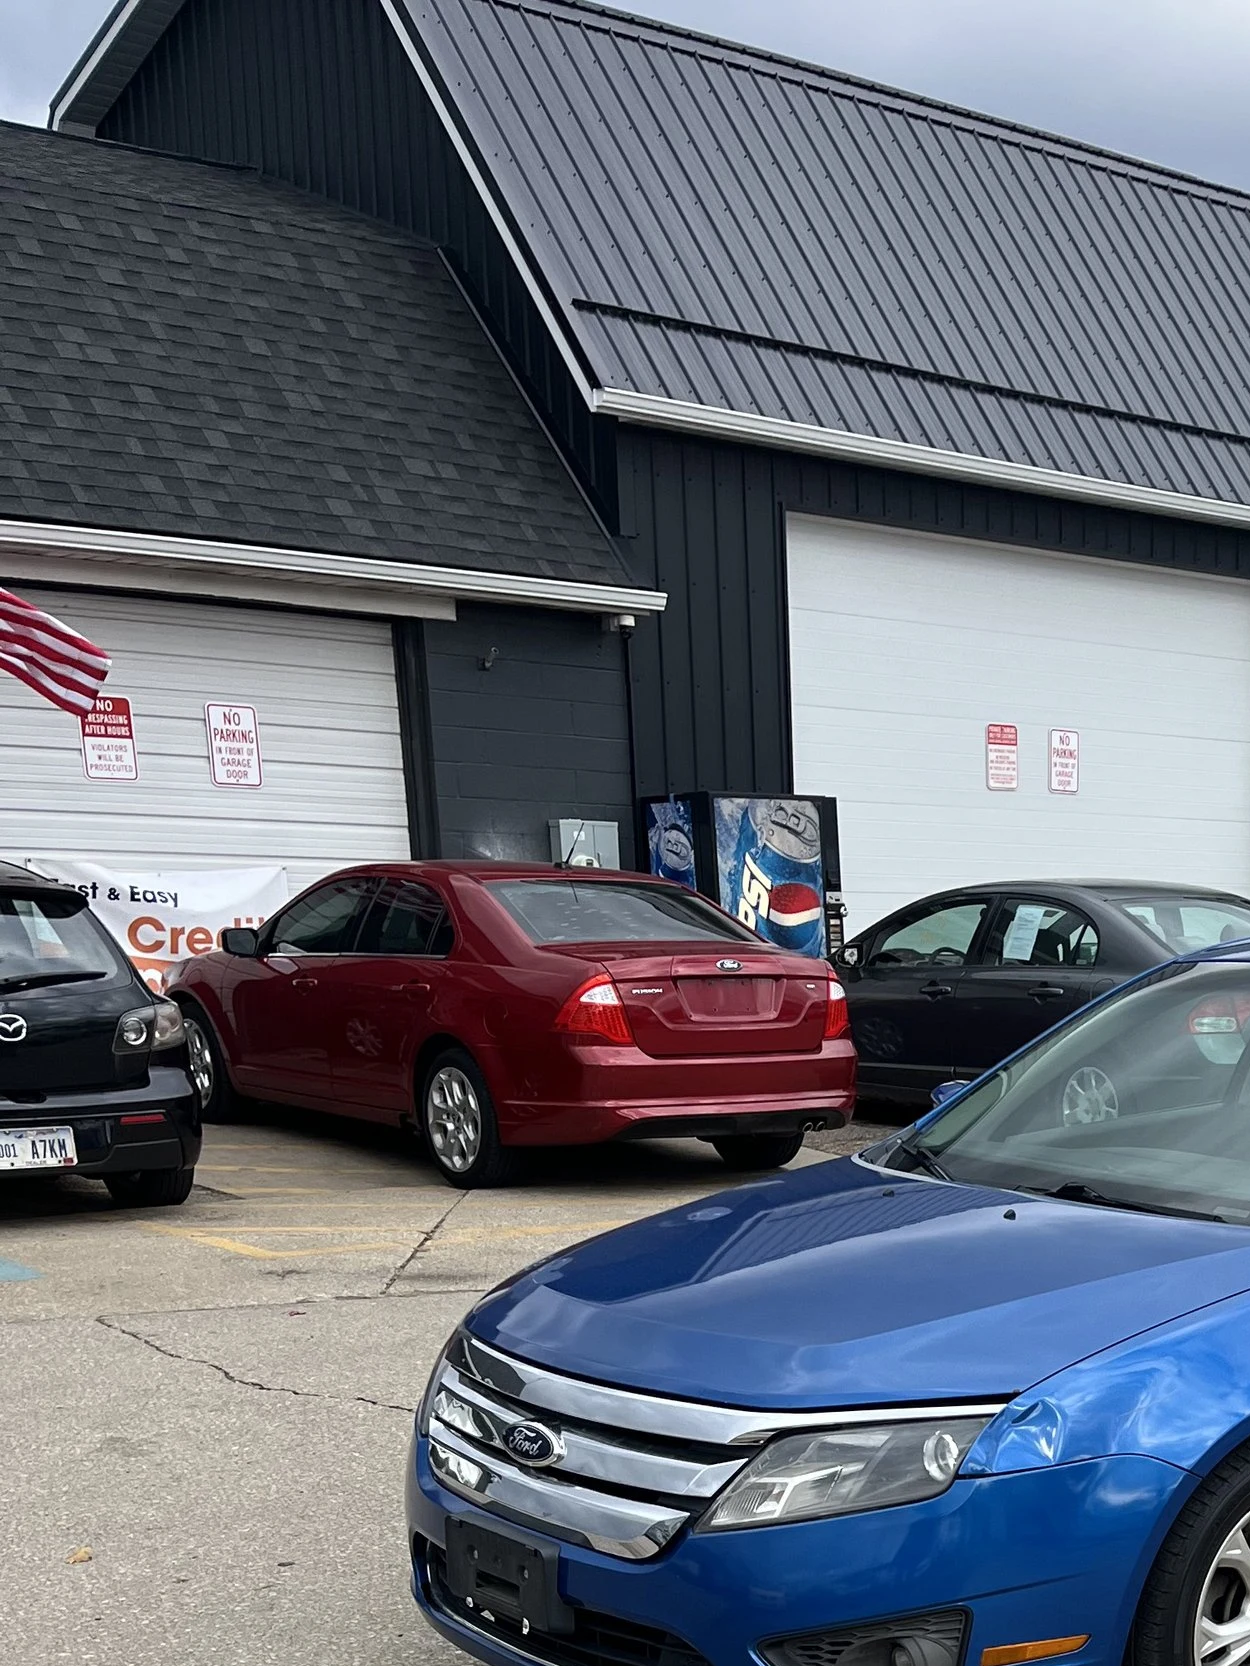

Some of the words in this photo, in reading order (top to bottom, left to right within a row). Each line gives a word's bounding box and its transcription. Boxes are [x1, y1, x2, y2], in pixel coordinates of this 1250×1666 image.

[95, 699, 113, 712] NO
[85, 713, 128, 725] RESPASSING
[223, 711, 241, 726] NO
[85, 724, 106, 735] AFTER
[106, 726, 130, 736] HOURS
[213, 728, 254, 744] PARKING
[1059, 735, 1071, 746] NO
[91, 743, 128, 753] VIOLATORS
[215, 746, 222, 755] IN
[225, 746, 244, 756] FRONT
[247, 747, 255, 757] OF
[1053, 747, 1076, 760] PARKING
[97, 754, 113, 762] WILL
[115, 754, 125, 763] BE
[220, 757, 252, 769] GARAGE
[90, 763, 133, 773] PROSECUTED
[1055, 769, 1073, 779] GARAGE
[226, 769, 249, 780] DOOR
[1057, 779, 1071, 787] DOOR
[107, 887, 120, 901] &
[129, 885, 178, 908] Easy
[738, 852, 772, 931] PSI
[127, 916, 264, 955] Cre
[508, 1427, 543, 1456] Ford
